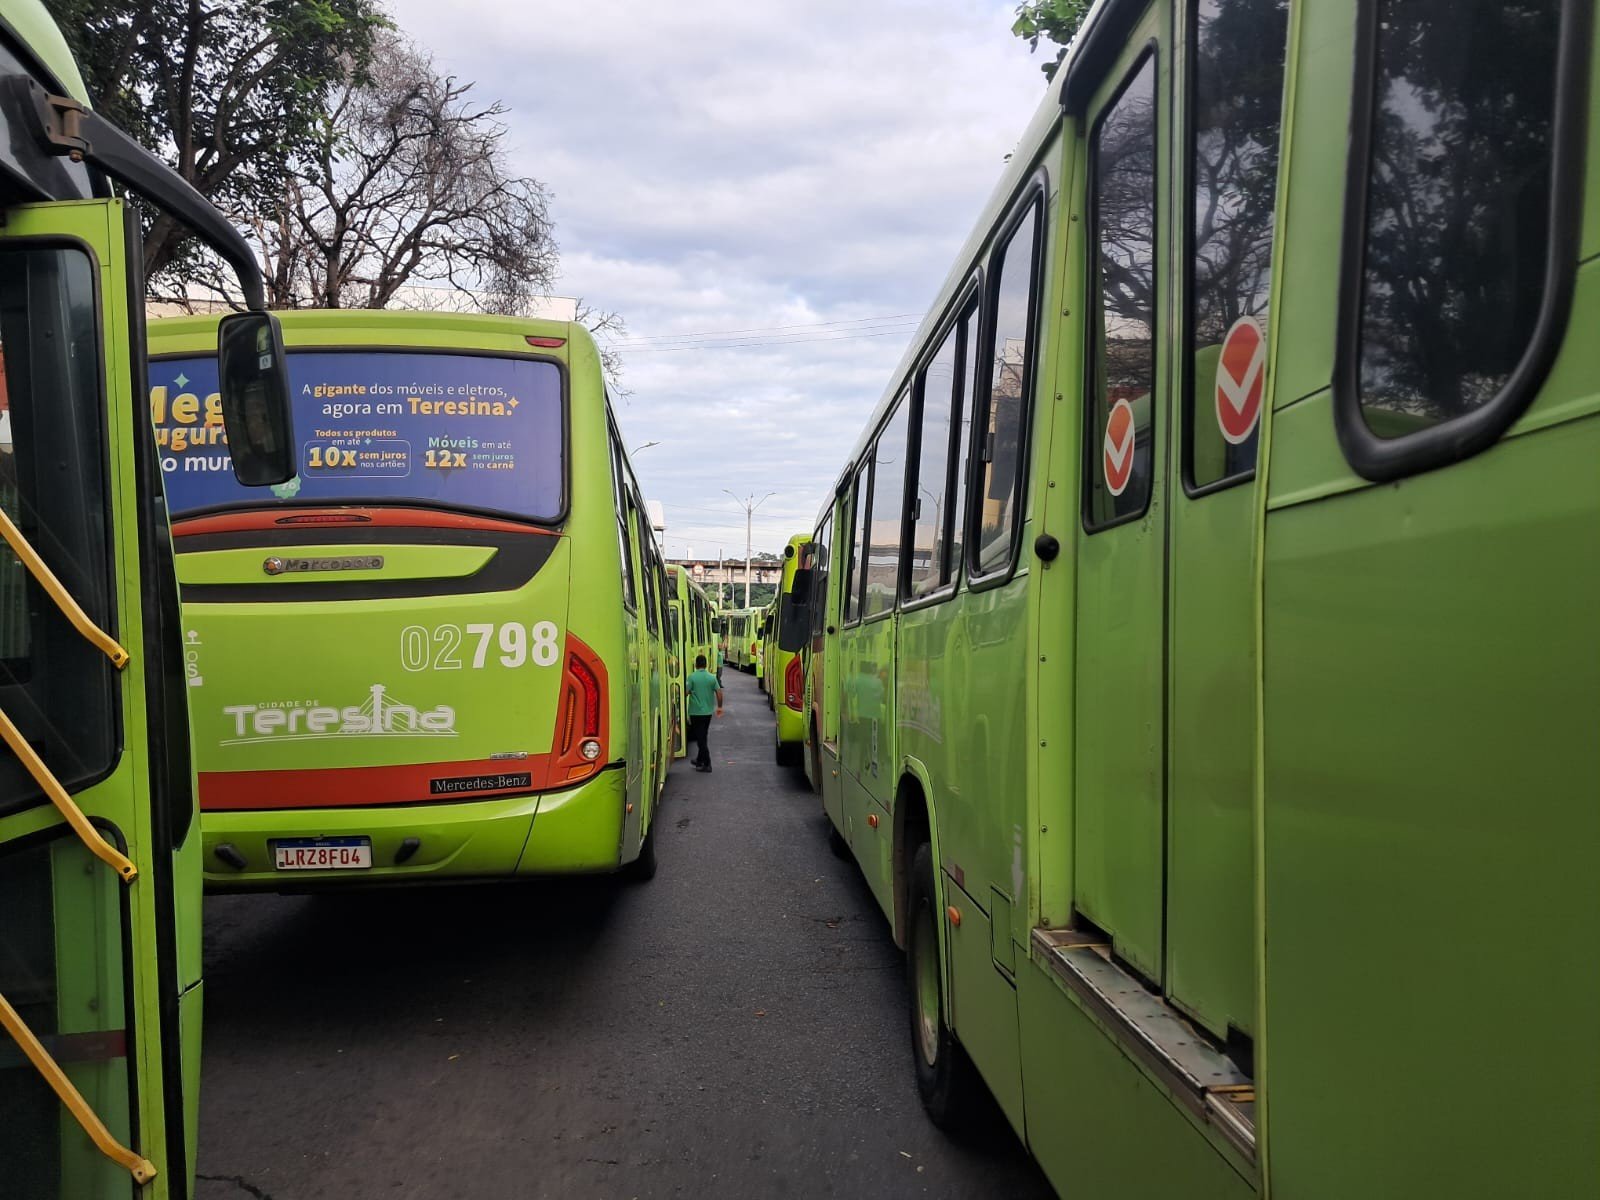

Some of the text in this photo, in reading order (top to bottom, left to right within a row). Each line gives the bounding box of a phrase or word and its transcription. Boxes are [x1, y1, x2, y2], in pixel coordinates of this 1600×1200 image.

[302, 382, 507, 398] A gigante dos móveis e eletros,
[322, 396, 512, 419] agora em Teresina.
[315, 429, 341, 437] Todos
[355, 429, 397, 438] produtos
[347, 437, 360, 446] até
[428, 435, 478, 449] Móveis
[497, 440, 511, 449] até
[308, 446, 407, 467] 10x sem juros
[425, 450, 467, 467] 12x
[492, 453, 514, 462] juros
[486, 461, 514, 469] carnê
[285, 559, 381, 571] Marcopolo
[401, 621, 559, 672] 02798
[259, 699, 320, 709] CIDADE DE
[435, 776, 528, 792] Mercedes-Benz
[285, 848, 361, 866] LRZ8F04
